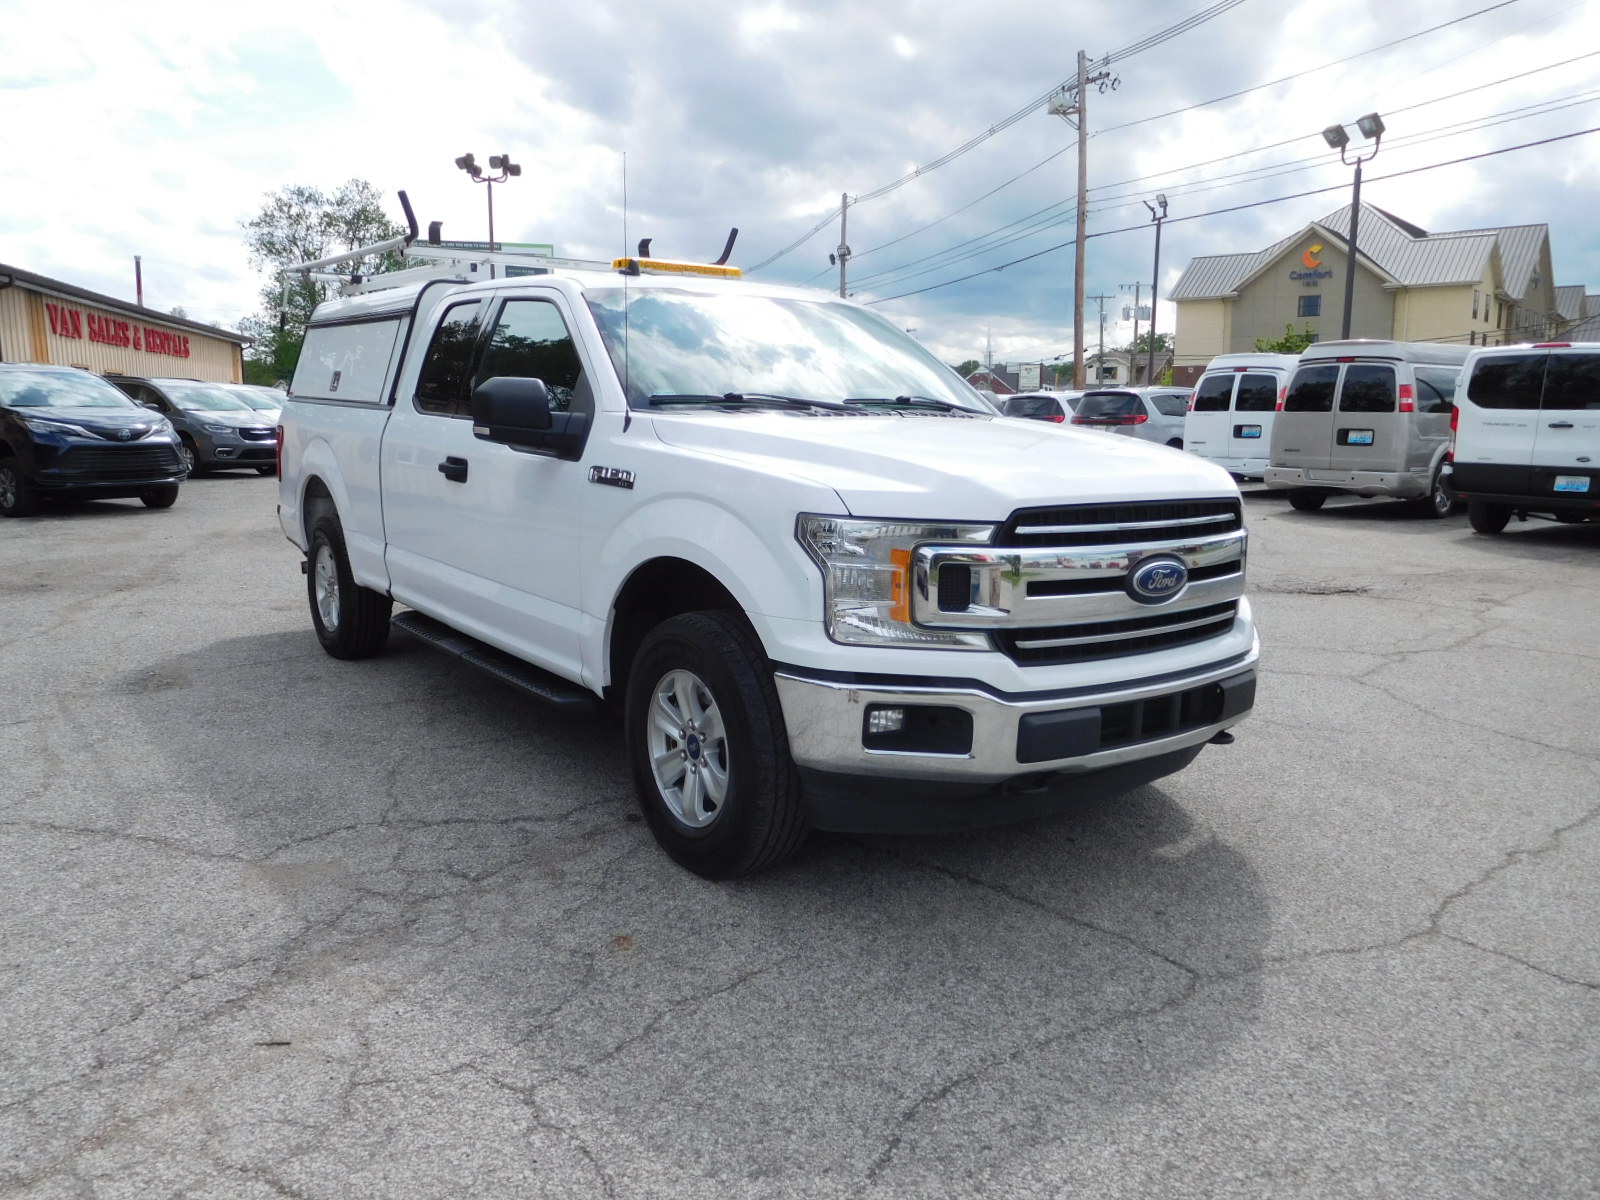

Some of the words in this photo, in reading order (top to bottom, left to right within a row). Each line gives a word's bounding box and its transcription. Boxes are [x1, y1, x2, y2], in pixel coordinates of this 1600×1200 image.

[45, 303, 83, 339] VAN
[88, 313, 130, 348] SALES
[133, 325, 143, 350] &
[144, 327, 191, 358] RENTALS
[1147, 569, 1178, 590] Ford
